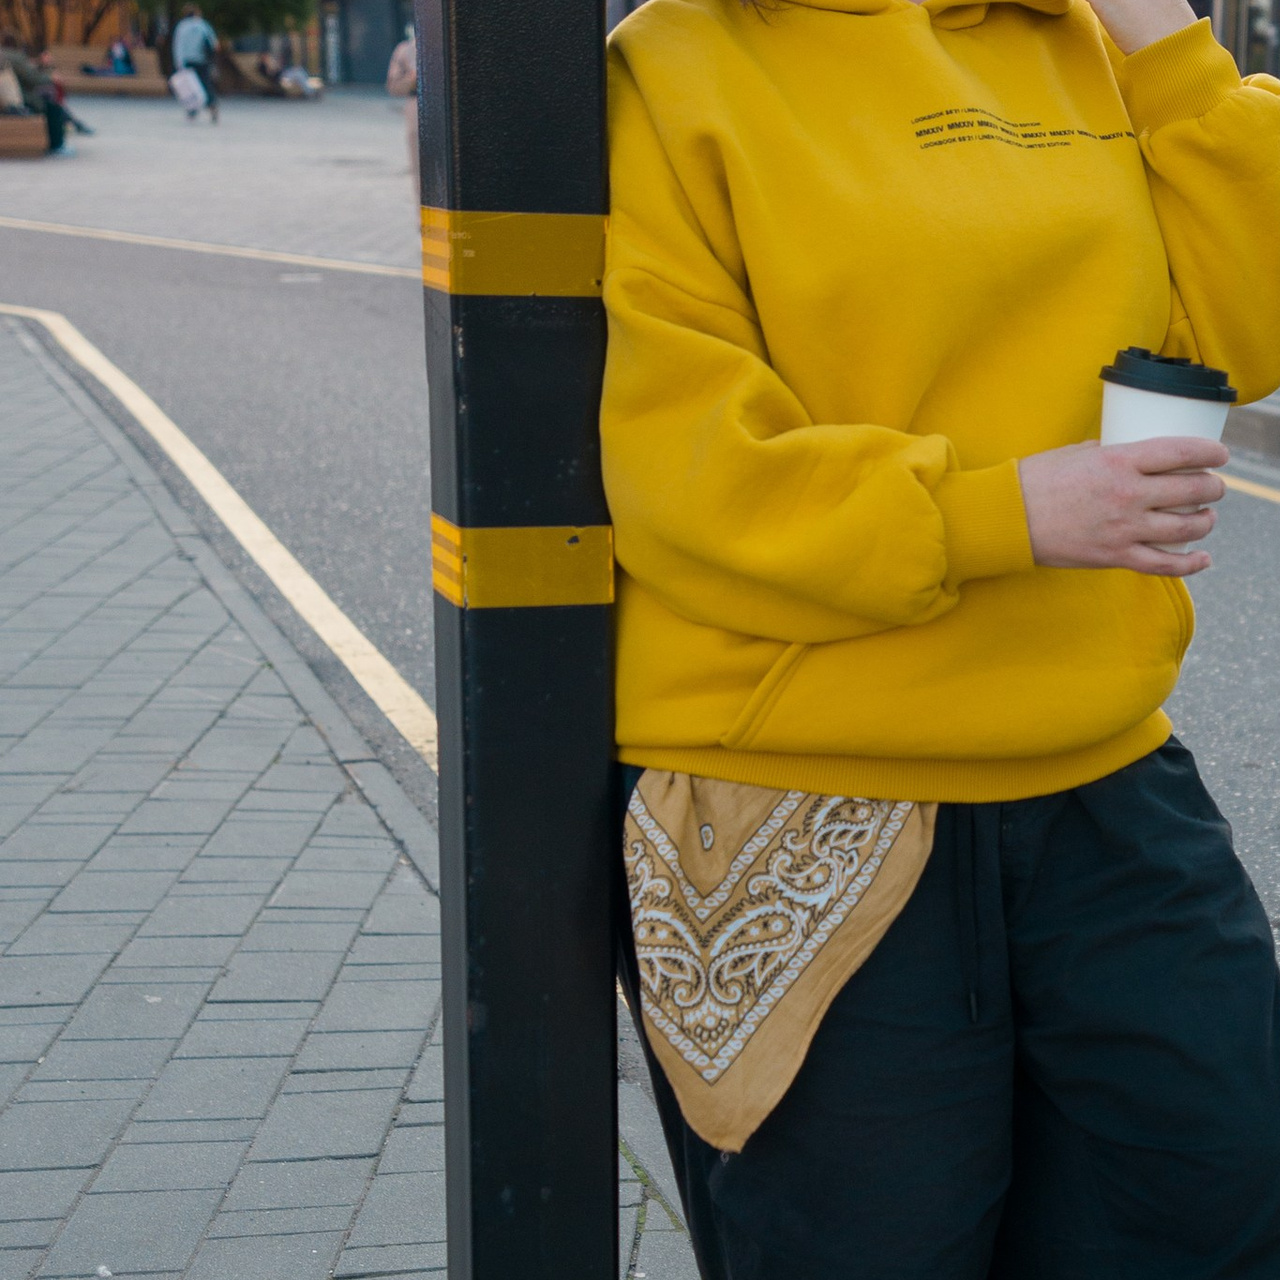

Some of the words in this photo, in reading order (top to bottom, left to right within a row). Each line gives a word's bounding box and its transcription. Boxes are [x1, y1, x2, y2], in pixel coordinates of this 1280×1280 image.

[915, 125, 944, 137] MMXIV
[947, 120, 974, 130] MMXIV
[1021, 131, 1046, 139] MMXIV
[1049, 129, 1074, 137] MMXIV
[1098, 131, 1123, 141] MMXIV
[920, 137, 956, 149] LOOKBOOK
